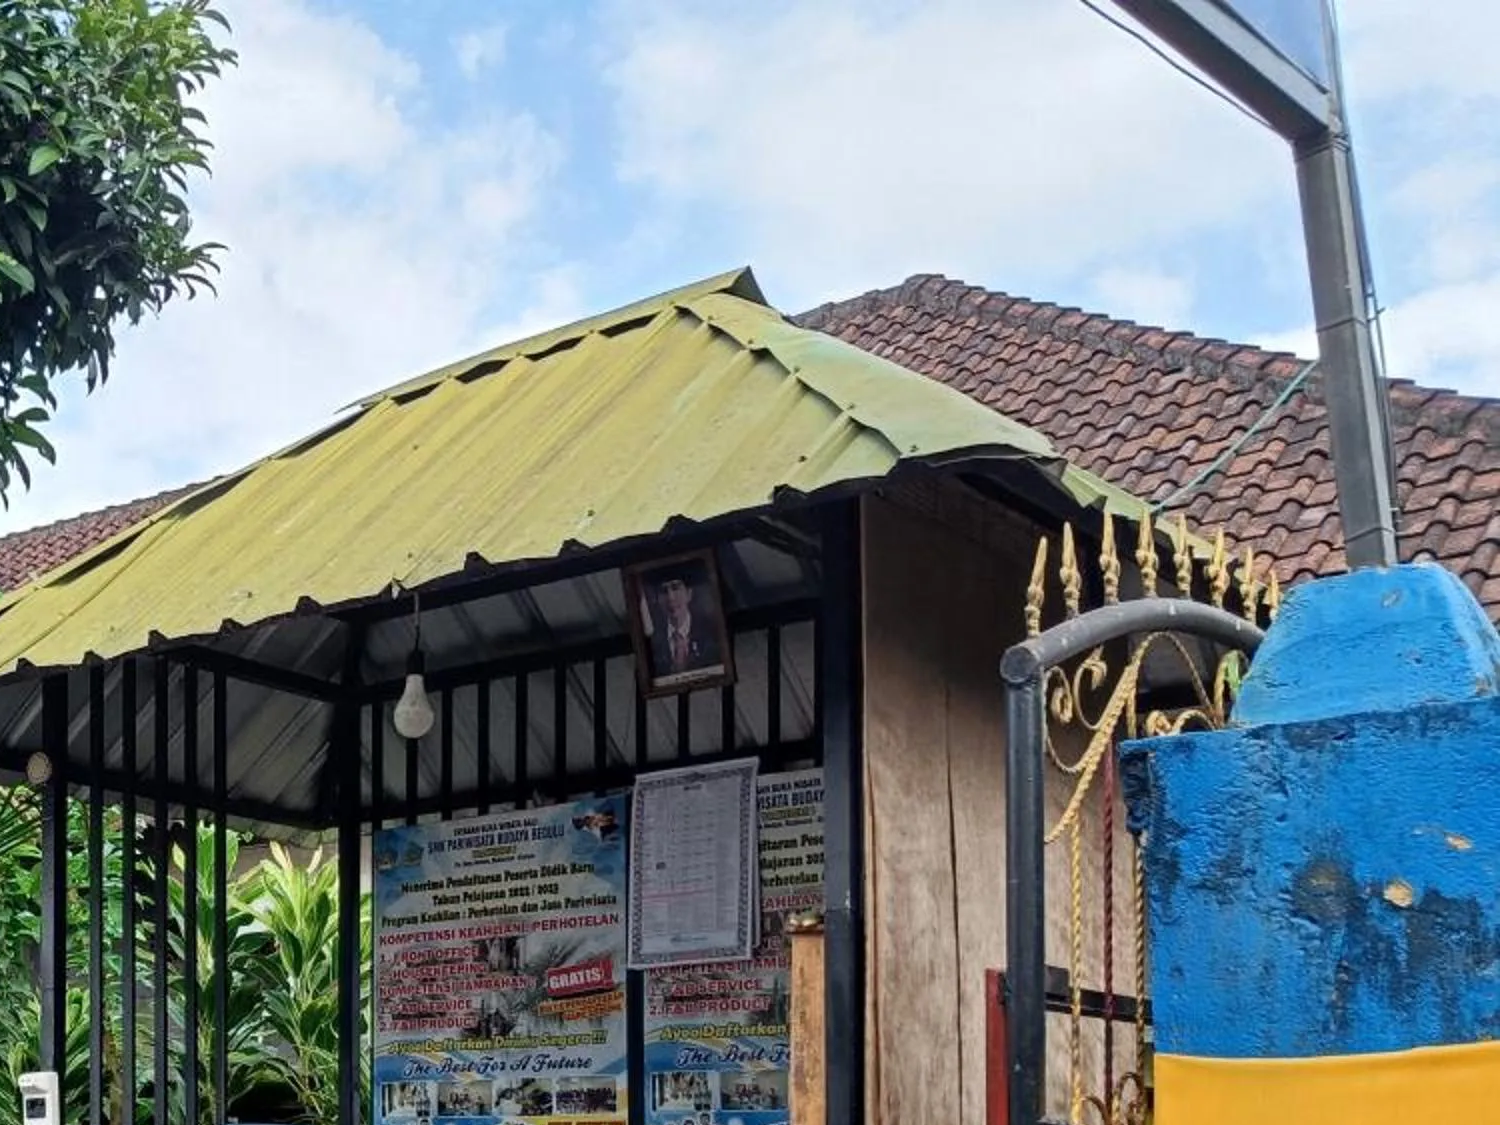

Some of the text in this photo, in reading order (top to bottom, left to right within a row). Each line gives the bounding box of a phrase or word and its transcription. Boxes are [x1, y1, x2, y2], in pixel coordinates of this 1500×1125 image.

[380, 929, 456, 945] KOMPETENSI
[532, 912, 619, 932] PERHOTELAN
[696, 979, 763, 995] SERVICE
[698, 998, 772, 1013] PRODUCT
[404, 1059, 430, 1076] The
[436, 1056, 476, 1074] Best
[476, 1055, 506, 1074] For
[531, 1053, 593, 1074] Future
[676, 1046, 709, 1067] The
[718, 1042, 766, 1062] Best
